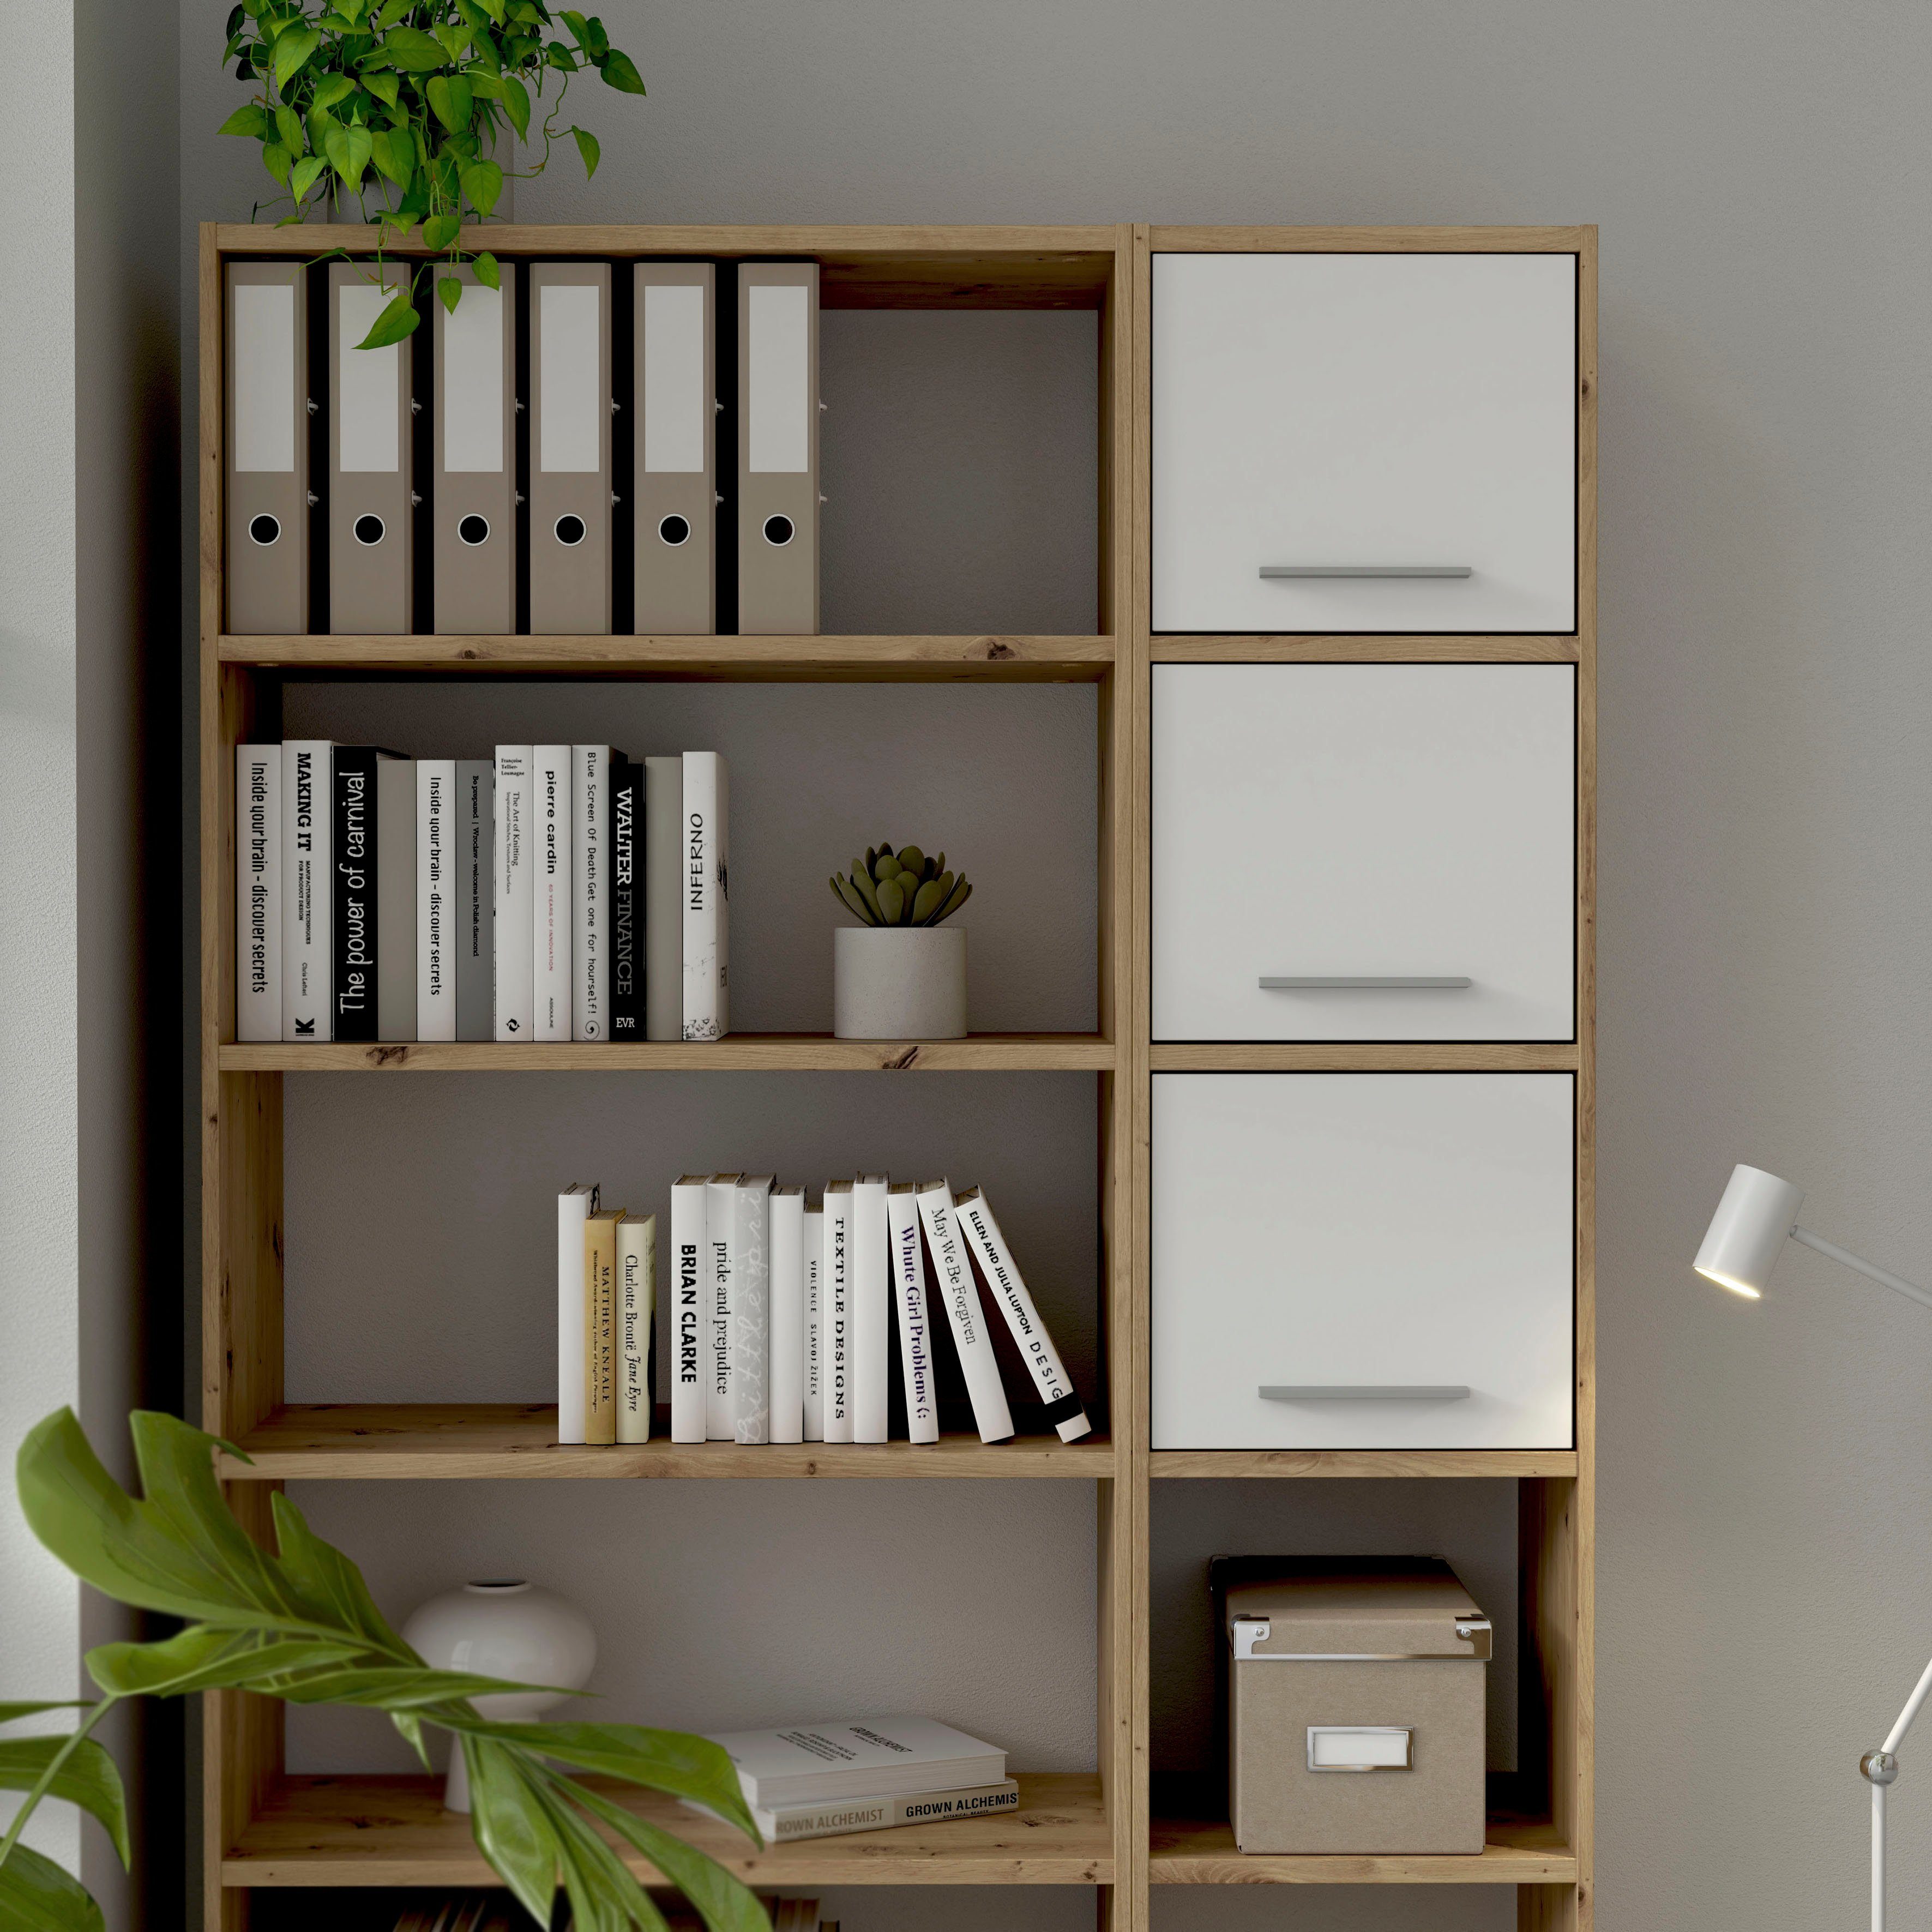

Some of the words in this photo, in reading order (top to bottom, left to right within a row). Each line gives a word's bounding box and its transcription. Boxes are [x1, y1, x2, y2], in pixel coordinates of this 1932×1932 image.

[252, 763, 268, 802] Inside
[473, 775, 479, 785] Be
[588, 753, 596, 777] Blue
[298, 753, 311, 827] MAKING
[431, 778, 441, 814] Inside
[545, 771, 556, 818] pierre
[588, 785, 596, 821] Screen
[250, 806, 264, 836] your
[339, 772, 365, 857] carnival
[429, 818, 439, 847] your
[298, 833, 311, 851] IT
[511, 834, 520, 866] Knitting
[547, 824, 556, 874] cardin
[588, 828, 597, 841] Of
[617, 787, 631, 886] WALTER
[252, 839, 268, 872] brain
[431, 850, 442, 881] brain
[588, 848, 596, 879] Death
[690, 814, 703, 910] INFERNO
[339, 863, 365, 888] of
[252, 886, 268, 942] discover
[346, 897, 373, 964] power
[431, 894, 442, 947] discover
[549, 918, 553, 927] OF
[588, 934, 597, 952] for
[617, 889, 632, 994] FINANCE
[252, 944, 268, 992] secrets
[431, 949, 442, 995] secrets
[340, 973, 365, 1014] The
[616, 1018, 635, 1027] EVR
[932, 1208, 947, 1237] May
[713, 1242, 731, 1282] pride
[901, 1225, 916, 1281] Whute
[942, 1240, 955, 1263] We
[626, 1255, 638, 1308] Charlotte
[682, 1245, 696, 1304] BRIAN
[947, 1265, 960, 1284] Be
[969, 1211, 988, 1240] ELLEN
[983, 1242, 999, 1263] AND
[995, 1266, 1013, 1295] JULIA
[1008, 1294, 1032, 1335] LUPTON
[717, 1287, 731, 1315] and
[907, 1287, 922, 1320] Girl
[953, 1285, 976, 1345] Forgiven
[626, 1313, 637, 1350] Brontë
[682, 1312, 696, 1382] CLARKE
[625, 1355, 641, 1383] Jane
[713, 1320, 731, 1394] prejudice
[835, 1320, 844, 1418] DESIGNS
[911, 1324, 926, 1403] Problems
[625, 1386, 641, 1411] Eyre
[816, 1808, 884, 1828] ALCHEMIST
[906, 1801, 952, 1817] GROWN
[956, 1792, 1019, 1810] ALCHEMIS
